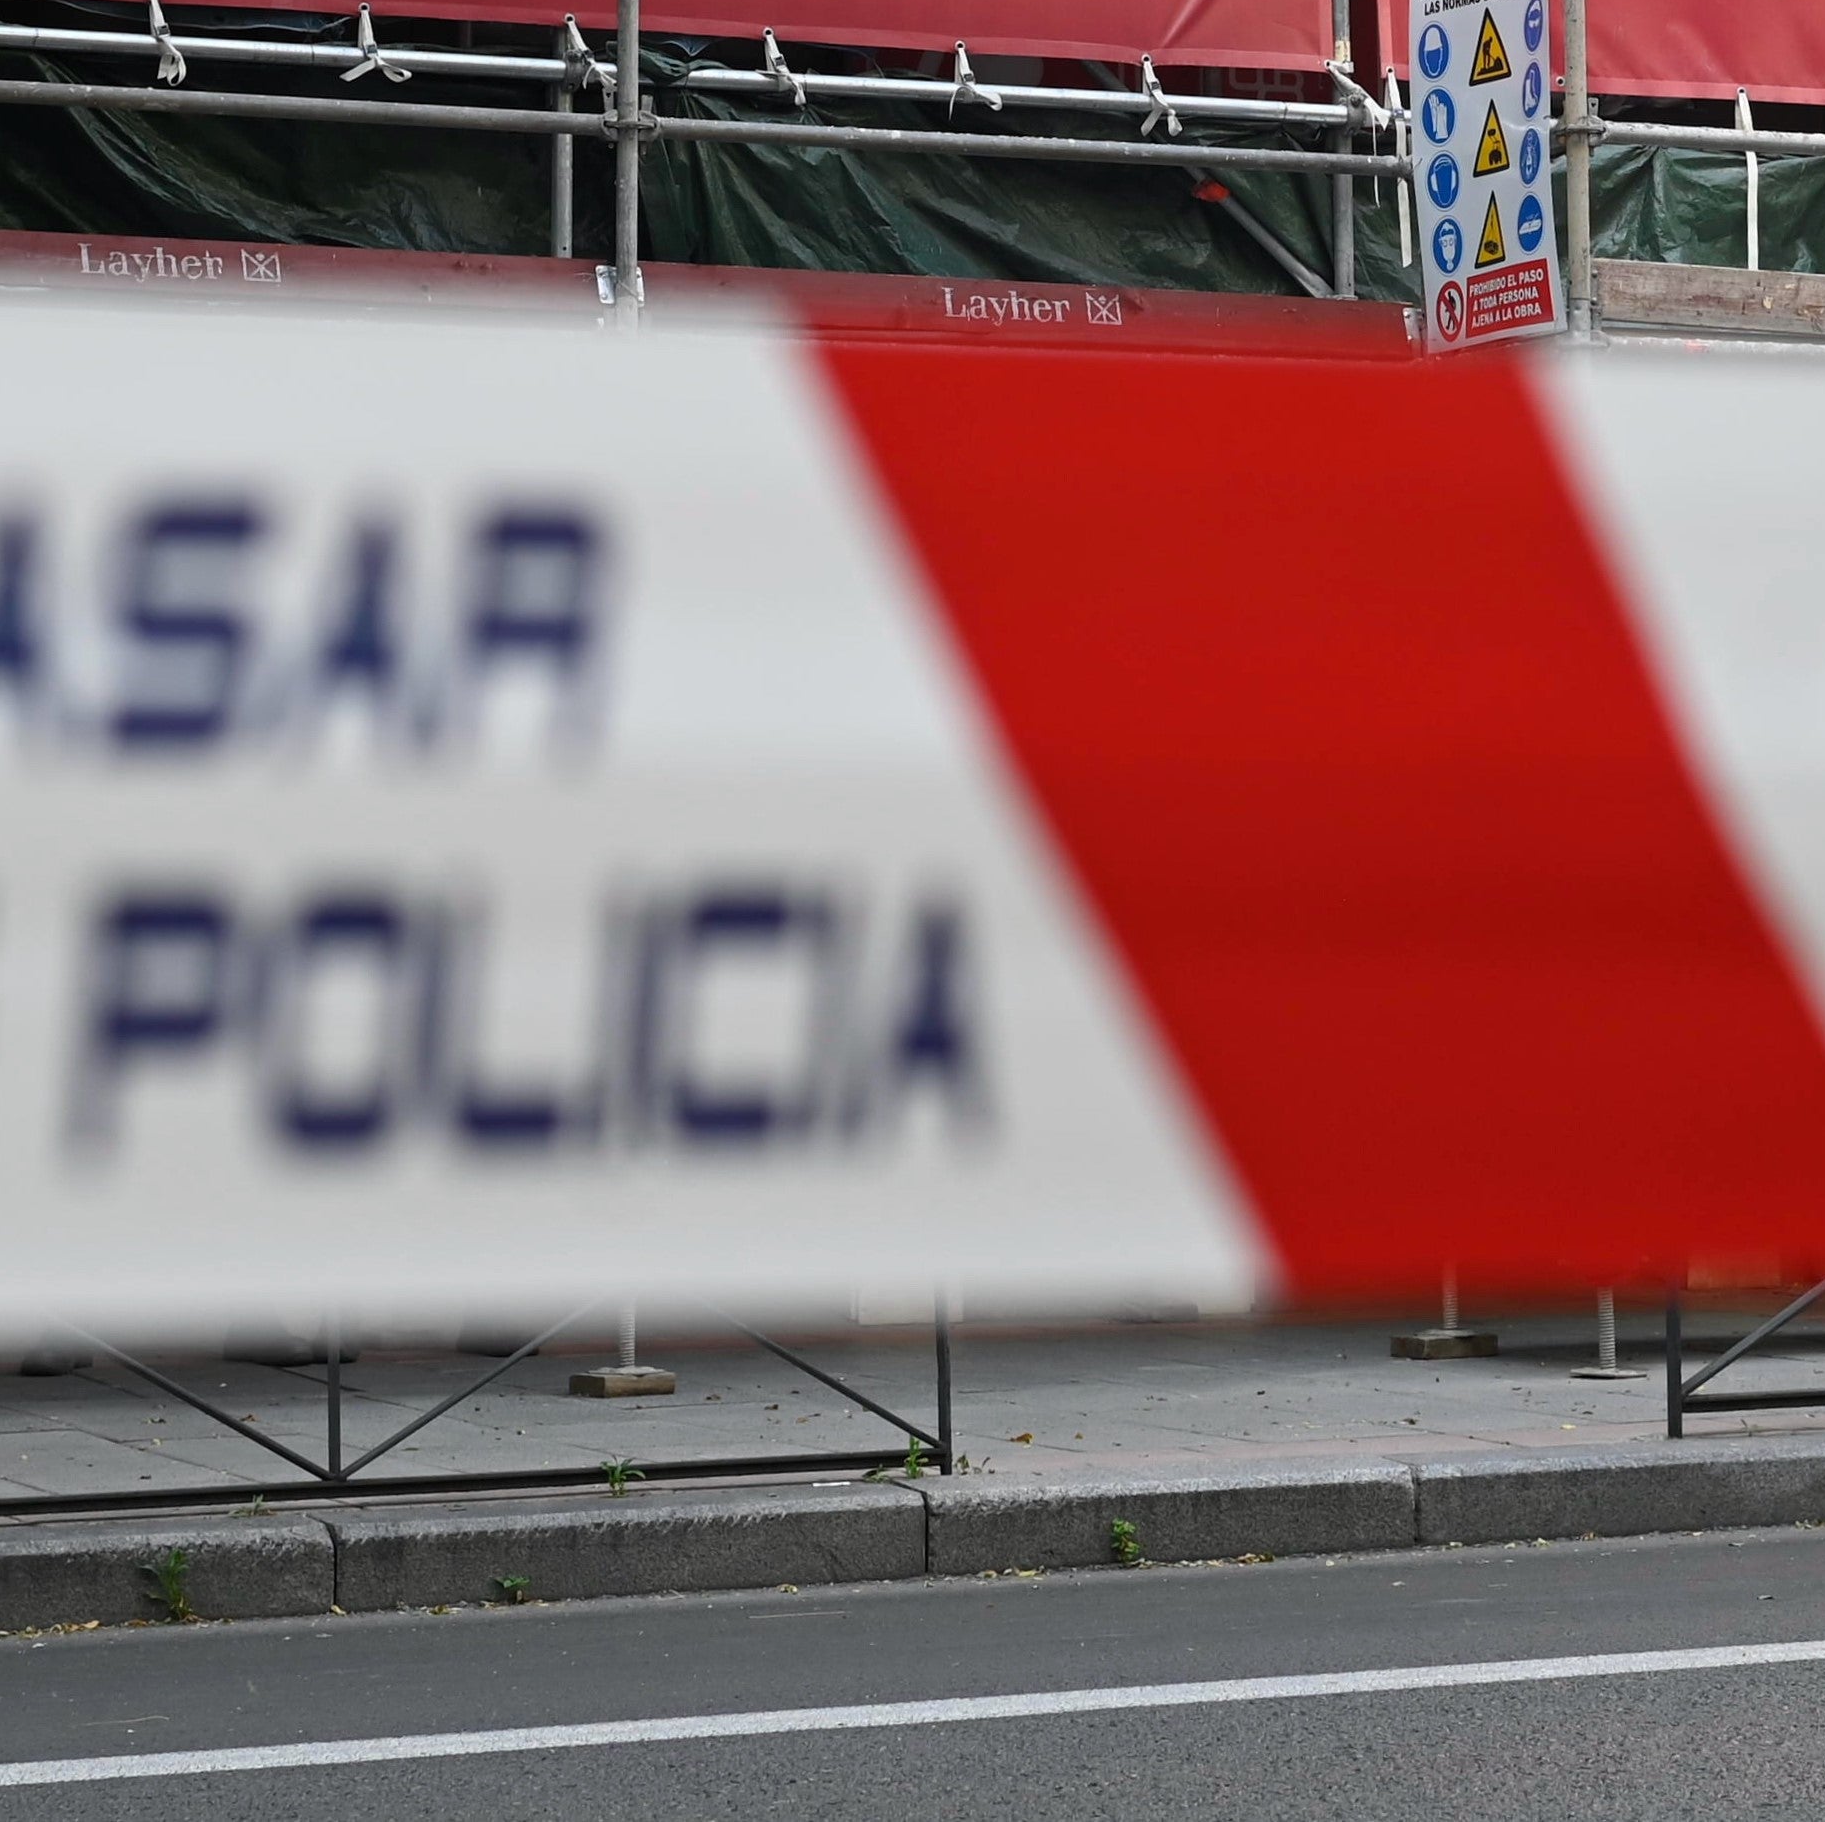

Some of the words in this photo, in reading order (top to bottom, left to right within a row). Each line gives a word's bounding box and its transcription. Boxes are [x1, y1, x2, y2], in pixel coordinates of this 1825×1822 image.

[1424, 1, 1440, 16] LAS
[77, 242, 224, 283] Layher
[1469, 276, 1506, 297] PROHIBIDO
[1507, 274, 1517, 287] EL
[1518, 268, 1544, 285] PASO
[941, 287, 1070, 327] Layher
[1473, 299, 1479, 312] A
[1479, 294, 1497, 310] TODA
[1498, 286, 1539, 305] PERSONA
[1471, 313, 1494, 329] AJENA
[1495, 311, 1501, 322] A
[1502, 307, 1512, 321] LA
[1514, 302, 1542, 318] OBRA
[64, 883, 999, 1168] POLICIA
